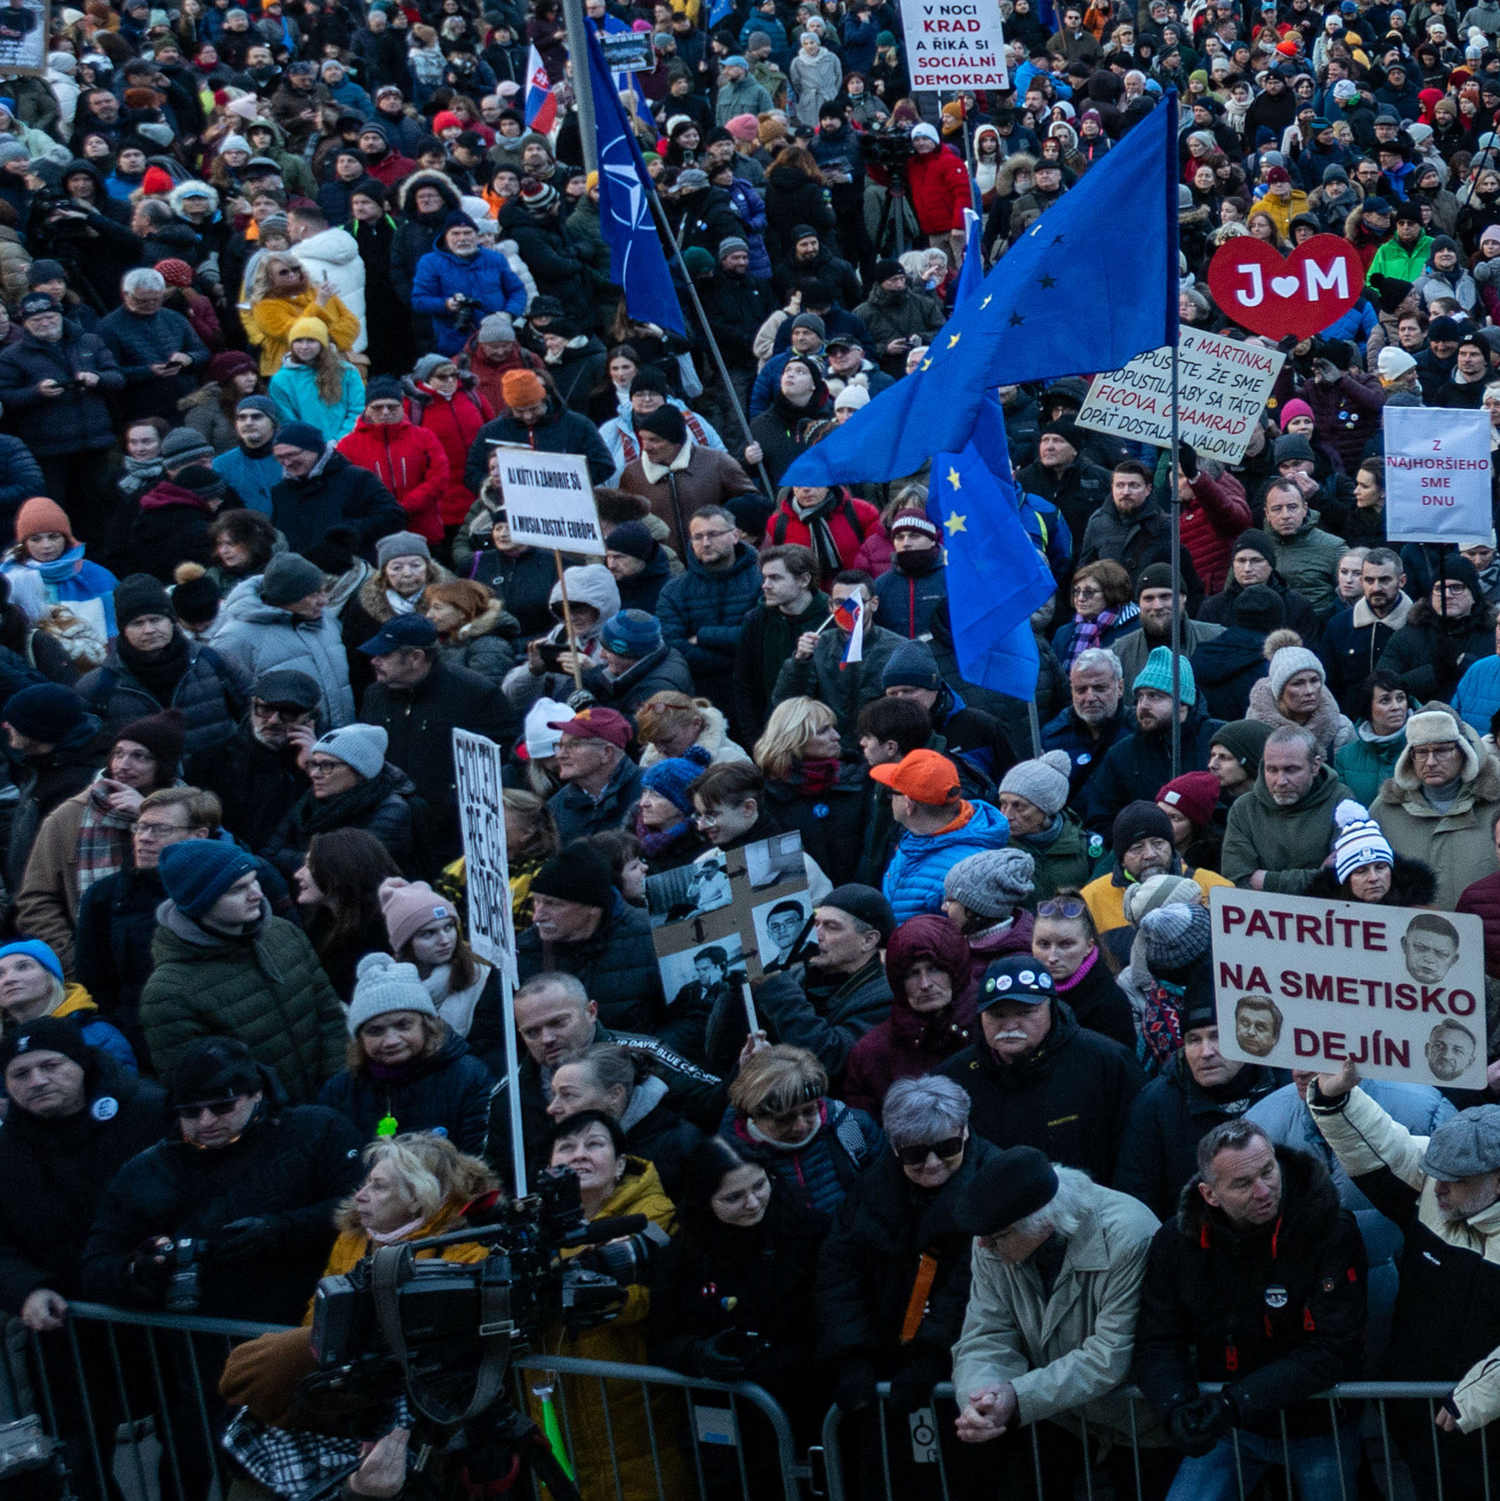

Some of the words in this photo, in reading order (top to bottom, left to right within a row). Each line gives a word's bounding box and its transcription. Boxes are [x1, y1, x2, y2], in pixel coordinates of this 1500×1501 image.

[923, 5, 933, 15] V
[940, 5, 977, 15] NOCI
[923, 19, 981, 33] KRAD
[916, 41, 927, 50] A
[933, 37, 969, 50] ŘÍKÁ
[975, 40, 989, 50] SI
[918, 53, 996, 68] SOCIÁLNÍ
[914, 73, 1003, 86] DEMOKRAT
[1236, 263, 1265, 307] J
[1304, 256, 1350, 302] M
[1197, 338, 1275, 376] MARTINKA,
[1206, 361, 1231, 384] ŽE
[1231, 374, 1264, 393] SME
[1096, 384, 1156, 414] FICOVA
[1162, 403, 1248, 435] CHAMRAĎ
[1178, 385, 1207, 402] ABY
[1206, 391, 1223, 409] SA
[1229, 392, 1261, 416] TÁTO
[1080, 405, 1119, 427] OPÄŤ
[1118, 416, 1173, 440] DOSTALA
[1180, 430, 1190, 441] K
[1193, 430, 1246, 458] VÁLOVU!
[1432, 440, 1441, 451] Z
[1387, 456, 1489, 470] NAJHORŠIEHO
[1421, 477, 1451, 488] SME
[1422, 495, 1455, 507] DNU
[1221, 905, 1388, 952] PATRÍTE
[1220, 961, 1271, 994] NA
[1280, 969, 1476, 1016] SMETISKO
[1293, 1027, 1410, 1068] DEJÍN
[656, 1048, 682, 1066] BLUE
